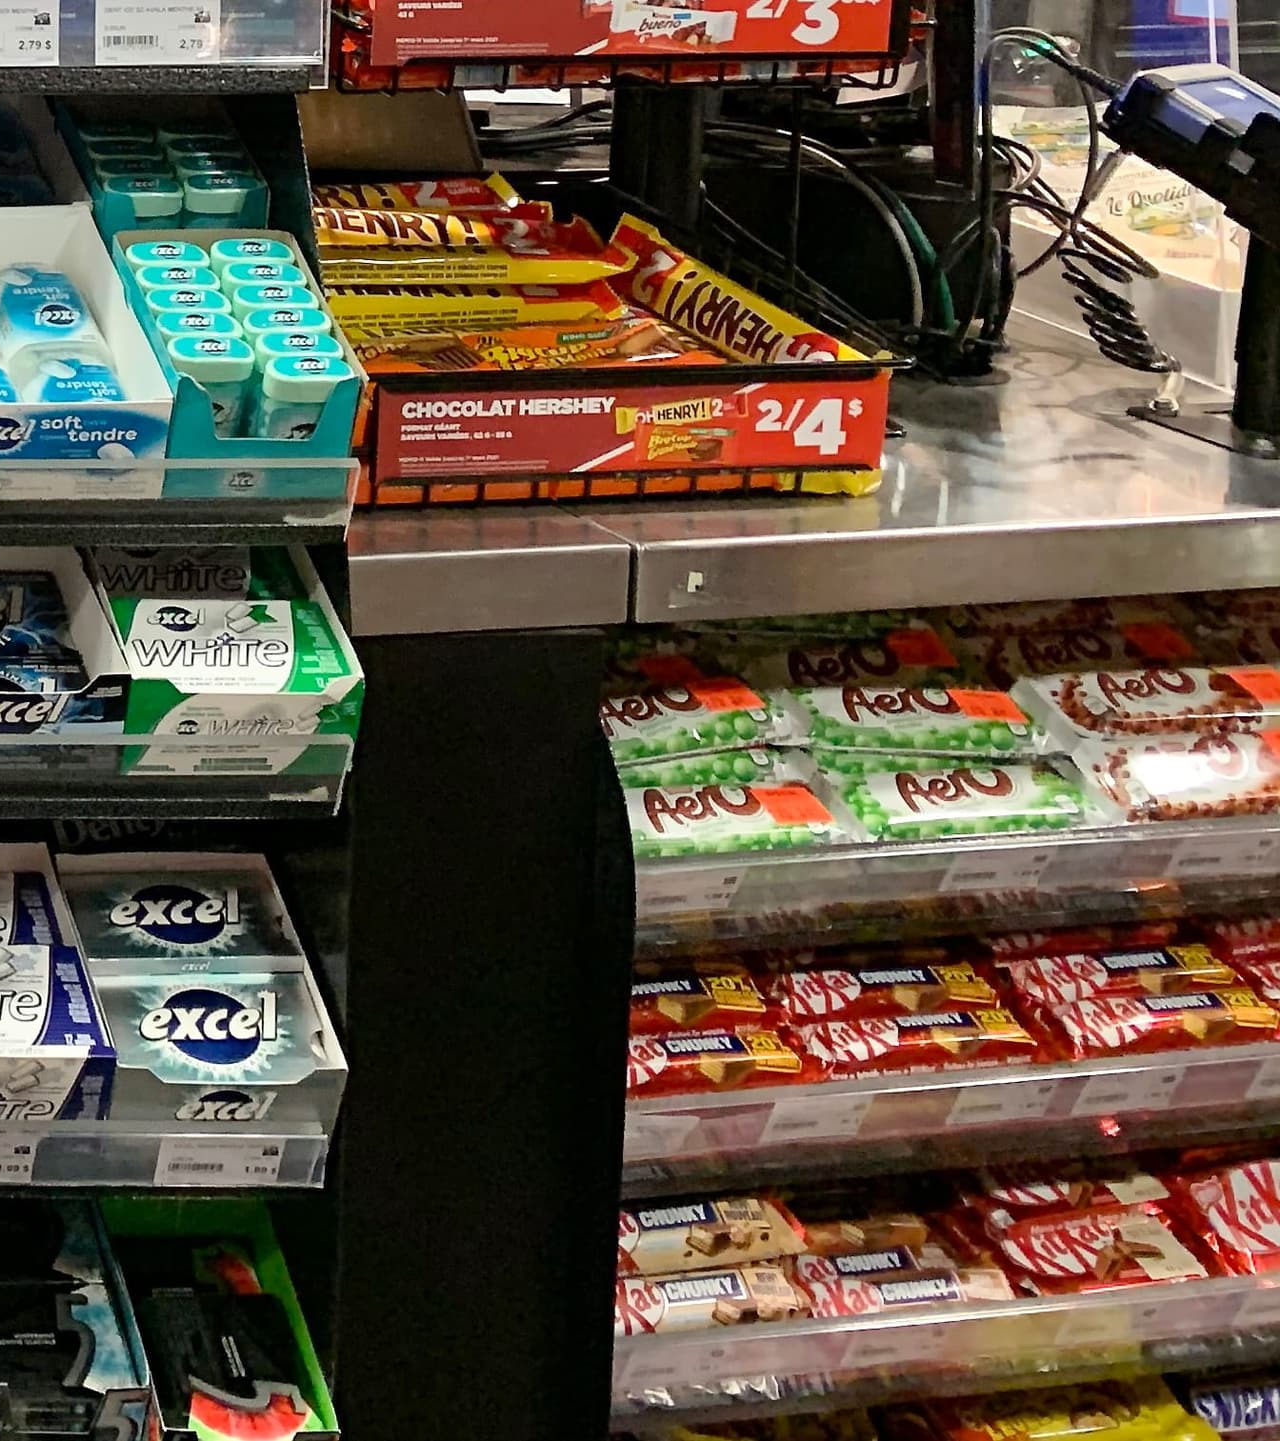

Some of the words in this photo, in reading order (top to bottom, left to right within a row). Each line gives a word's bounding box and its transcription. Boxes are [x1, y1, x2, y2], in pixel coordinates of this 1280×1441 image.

[638, 18, 683, 32] bueno
[44, 38, 52, 50] $
[314, 209, 473, 247] HENRY!
[401, 399, 516, 419] CHOCOLAT
[519, 396, 617, 417] HERSHEY
[657, 401, 707, 421] HENRY!
[711, 398, 724, 418] 2
[40, 414, 83, 430] soft
[754, 398, 848, 456] 2/4
[848, 397, 864, 419] $
[68, 426, 138, 442] tendre
[1096, 666, 1196, 709] Aero
[895, 766, 1017, 812] Aero
[108, 885, 241, 929] excel
[1102, 951, 1168, 969] CHUNKY
[858, 969, 927, 984] CHUNKY
[1145, 993, 1214, 1010] CHUNKY
[139, 990, 281, 1042] excel
[895, 1010, 963, 1027] CHUNKY
[665, 1037, 733, 1053] CHUNKY
[174, 1090, 278, 1122] excel
[639, 1204, 707, 1228] CHUNKY
[837, 1251, 902, 1274] CHUNKY
[666, 1276, 734, 1302] CHUNKY
[880, 1279, 950, 1302] CHUNKY
